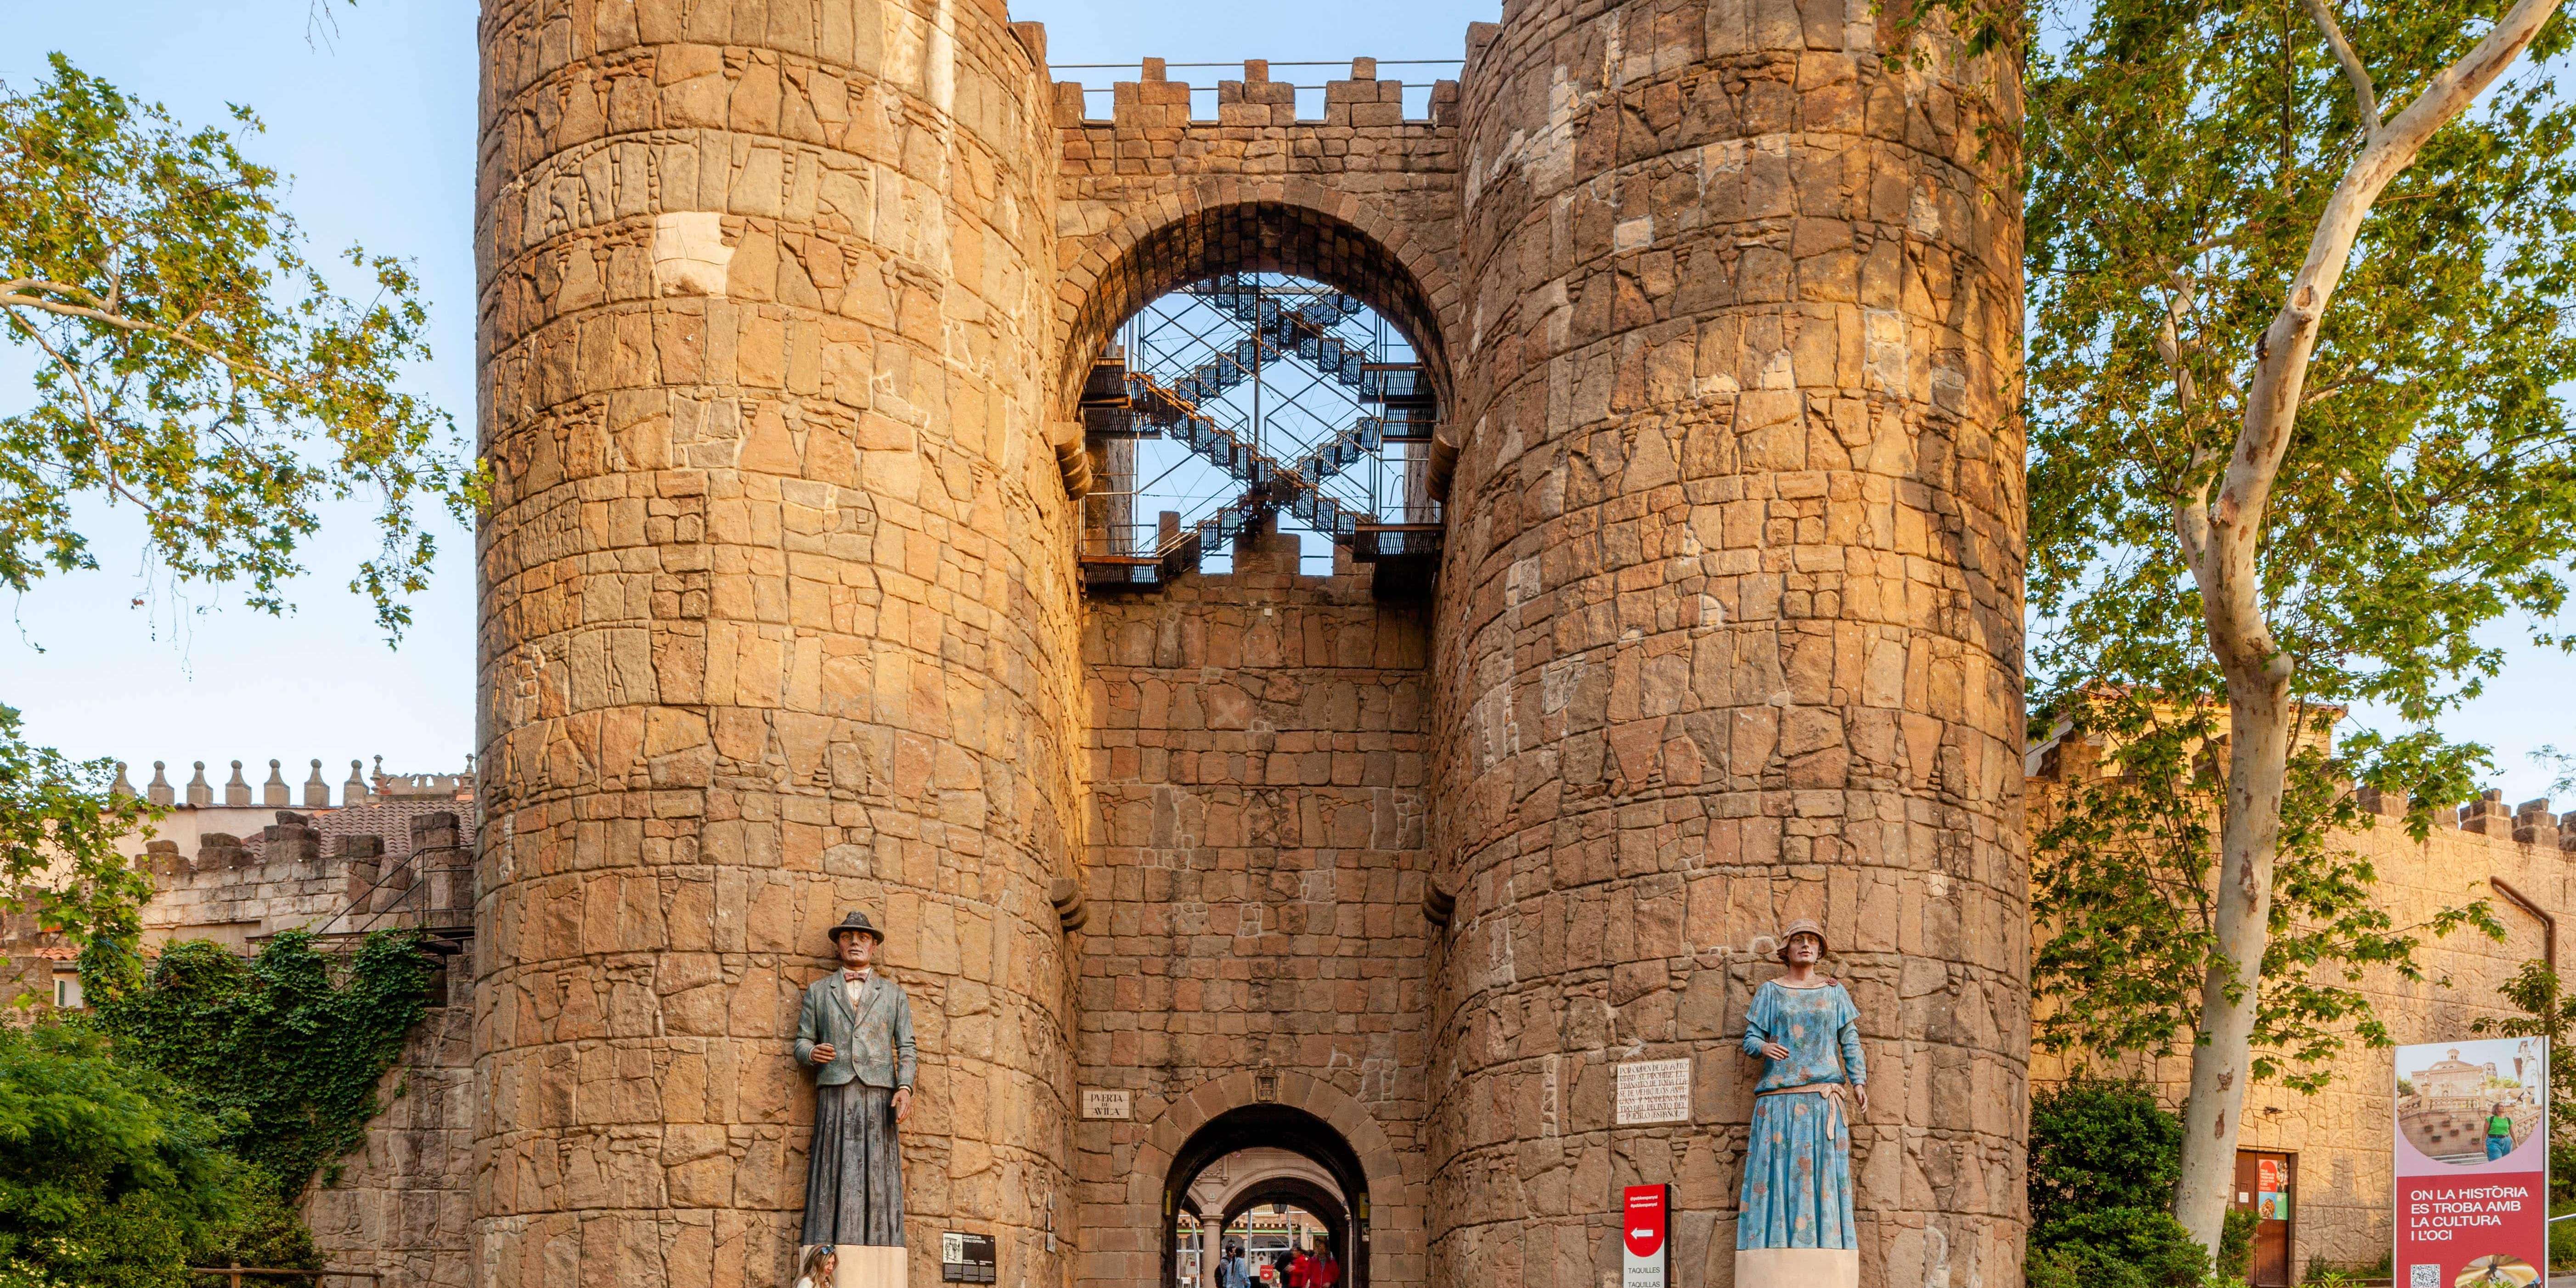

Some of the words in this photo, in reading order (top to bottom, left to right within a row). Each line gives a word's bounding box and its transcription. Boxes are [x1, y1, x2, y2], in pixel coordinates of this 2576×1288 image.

[2411, 1191, 2433, 1200] ON
[2437, 1190, 2456, 1200] LA
[2459, 1186, 2528, 1199] HISTÒRIA
[2411, 1204, 2429, 1214] ES
[2433, 1202, 2483, 1214] TROBA
[2486, 1201, 2521, 1212] AMB
[2411, 1217, 2429, 1227] LA
[2432, 1215, 2502, 1227] CULTURA
[2411, 1231, 2414, 1241] I
